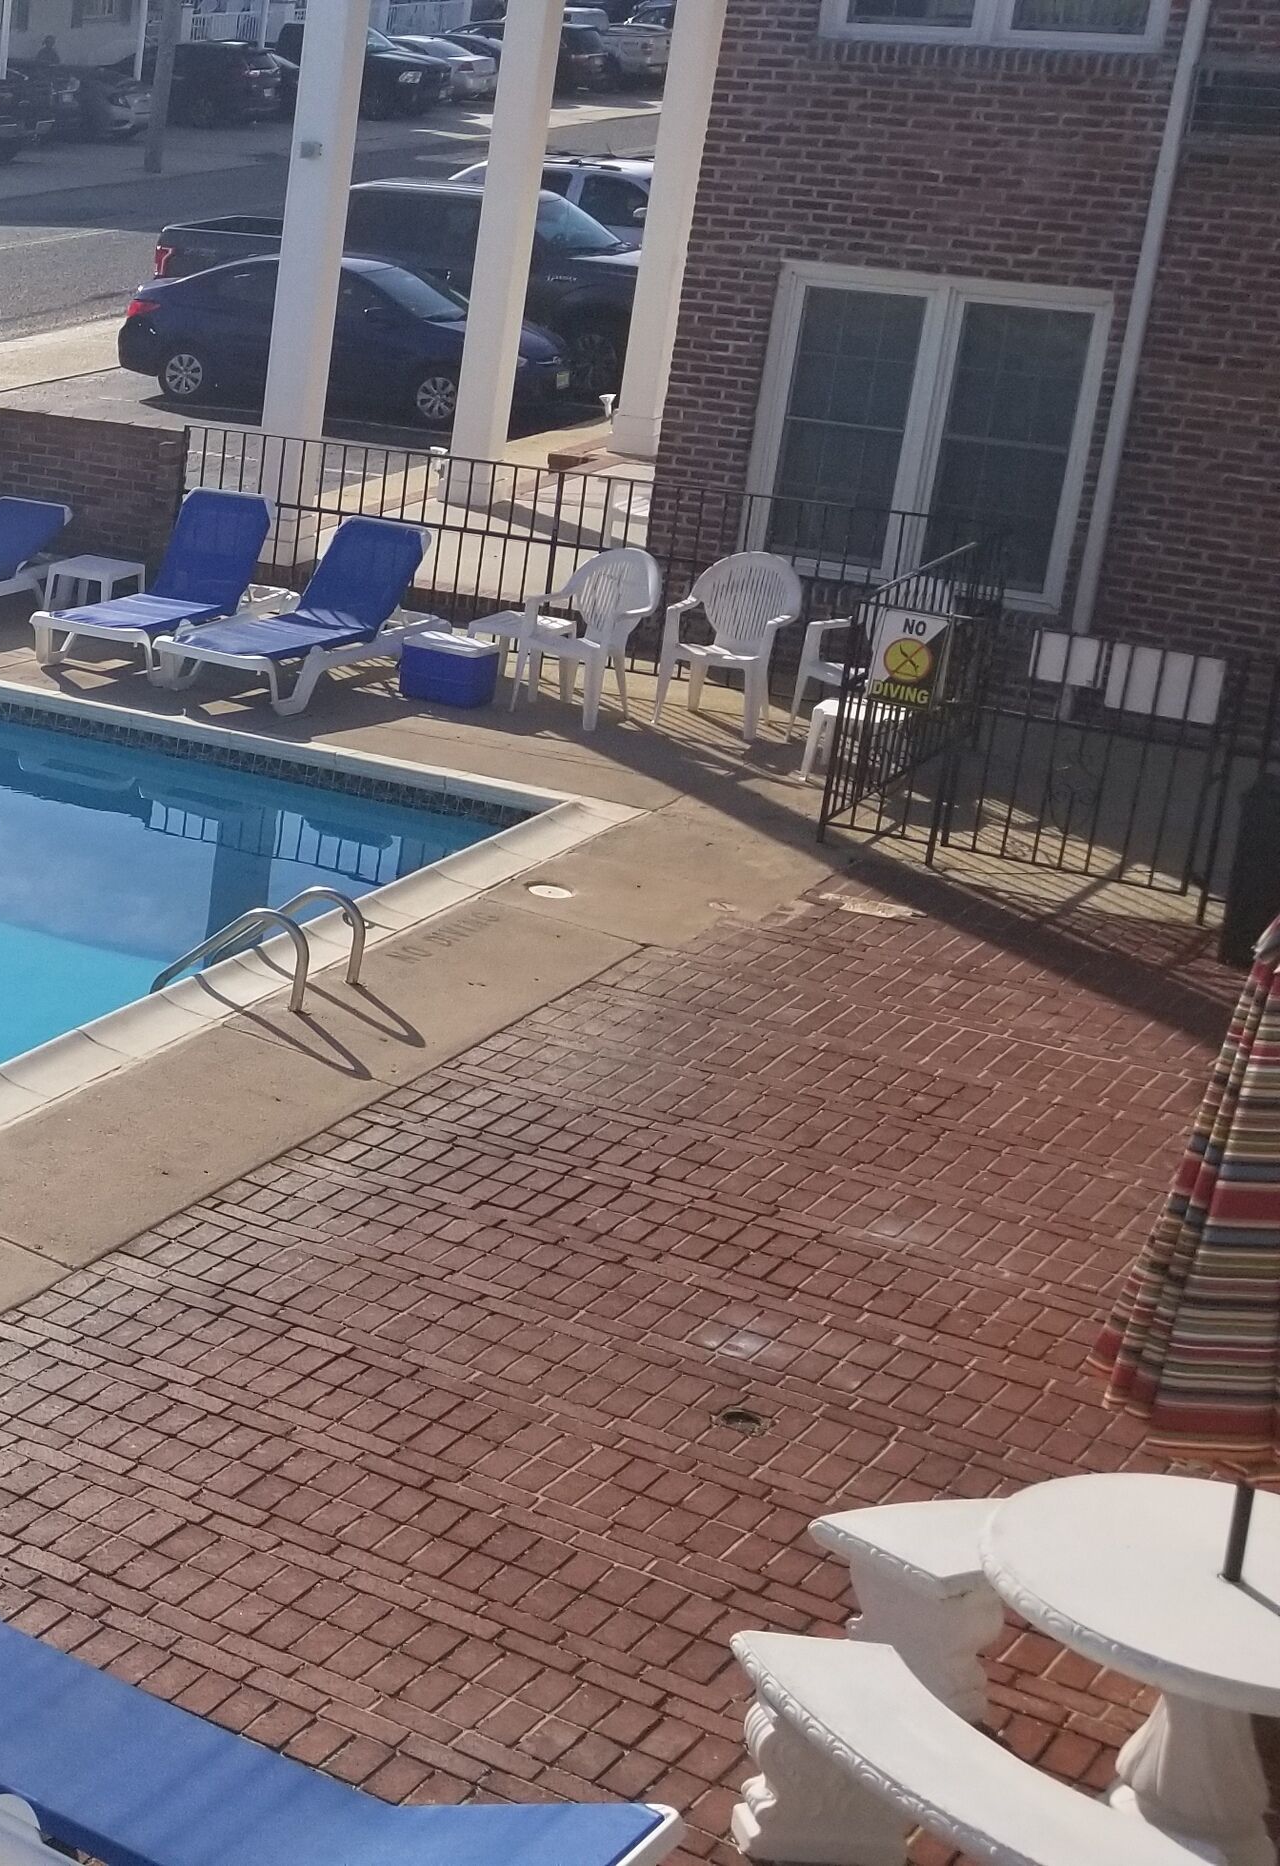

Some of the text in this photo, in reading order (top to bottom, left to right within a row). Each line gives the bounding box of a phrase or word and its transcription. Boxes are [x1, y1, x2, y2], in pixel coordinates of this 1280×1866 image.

[902, 618, 927, 637] NO
[872, 680, 930, 704] DIVING
[385, 946, 433, 964] NO
